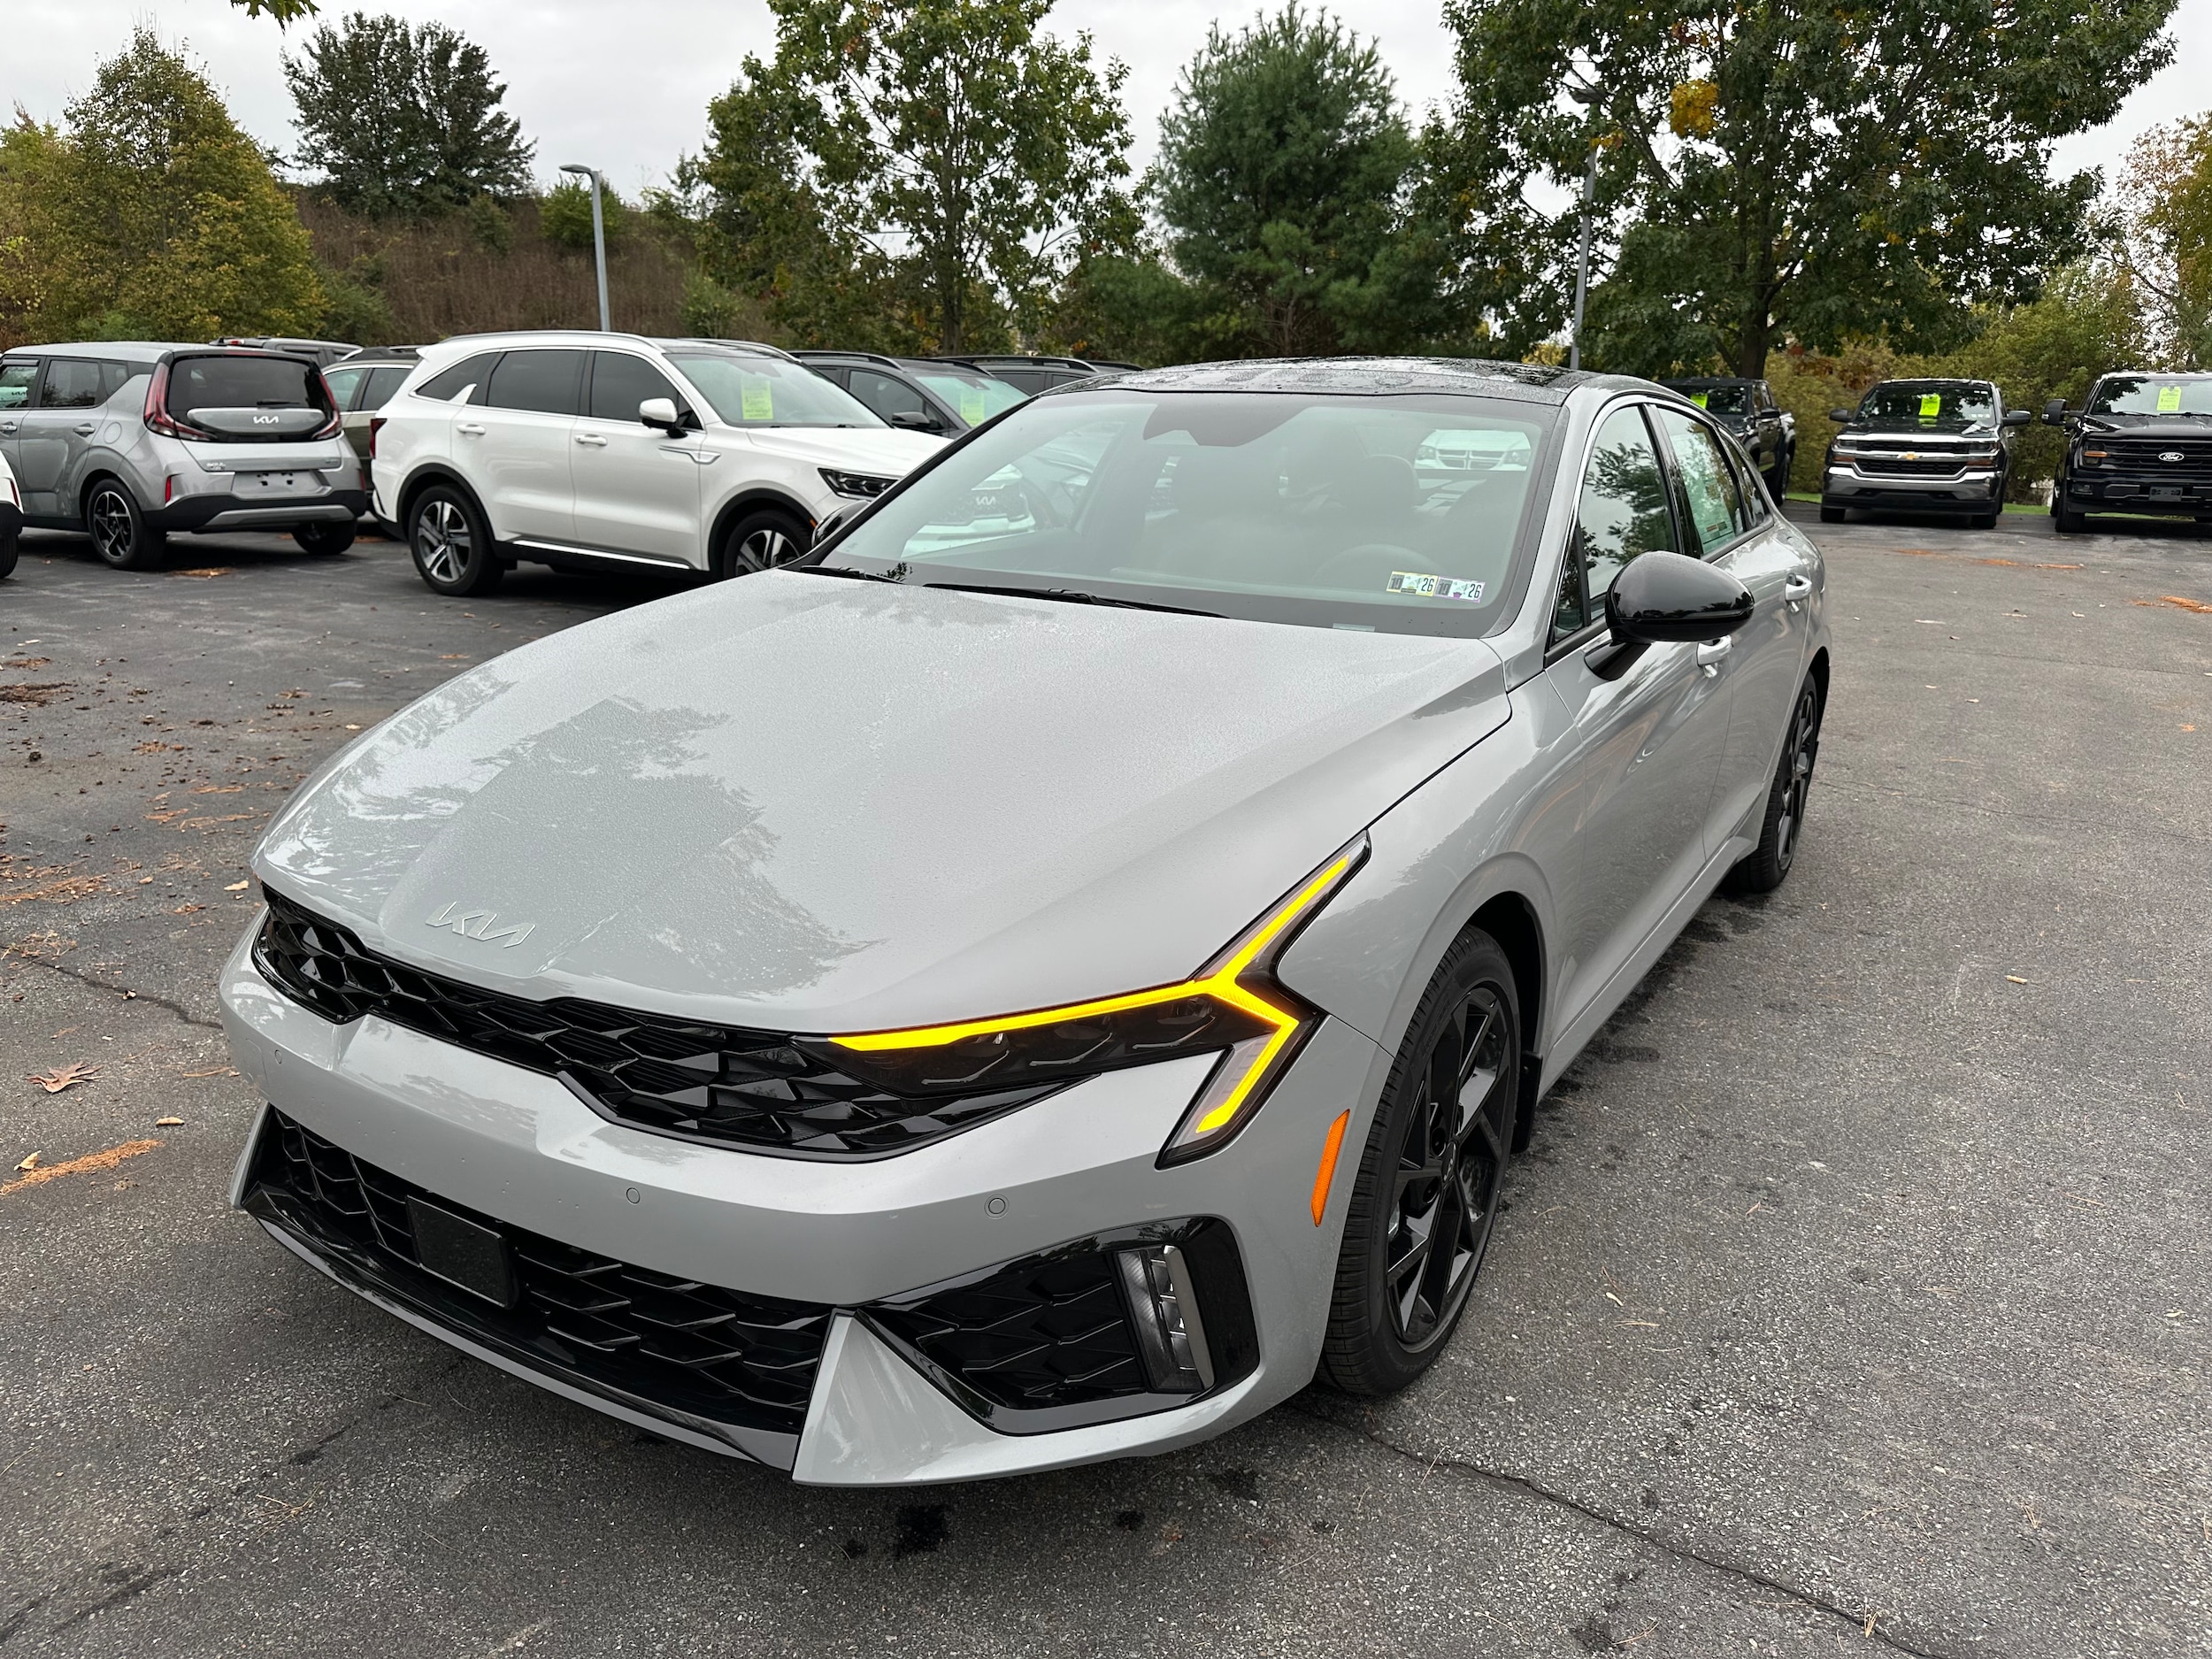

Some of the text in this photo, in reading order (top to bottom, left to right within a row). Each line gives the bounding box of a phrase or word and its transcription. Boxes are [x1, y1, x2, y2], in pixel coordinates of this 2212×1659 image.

[976, 495, 996, 505] KIA
[1421, 577, 1435, 592] 26
[1469, 583, 1482, 598] 26
[426, 901, 536, 949] KIA
